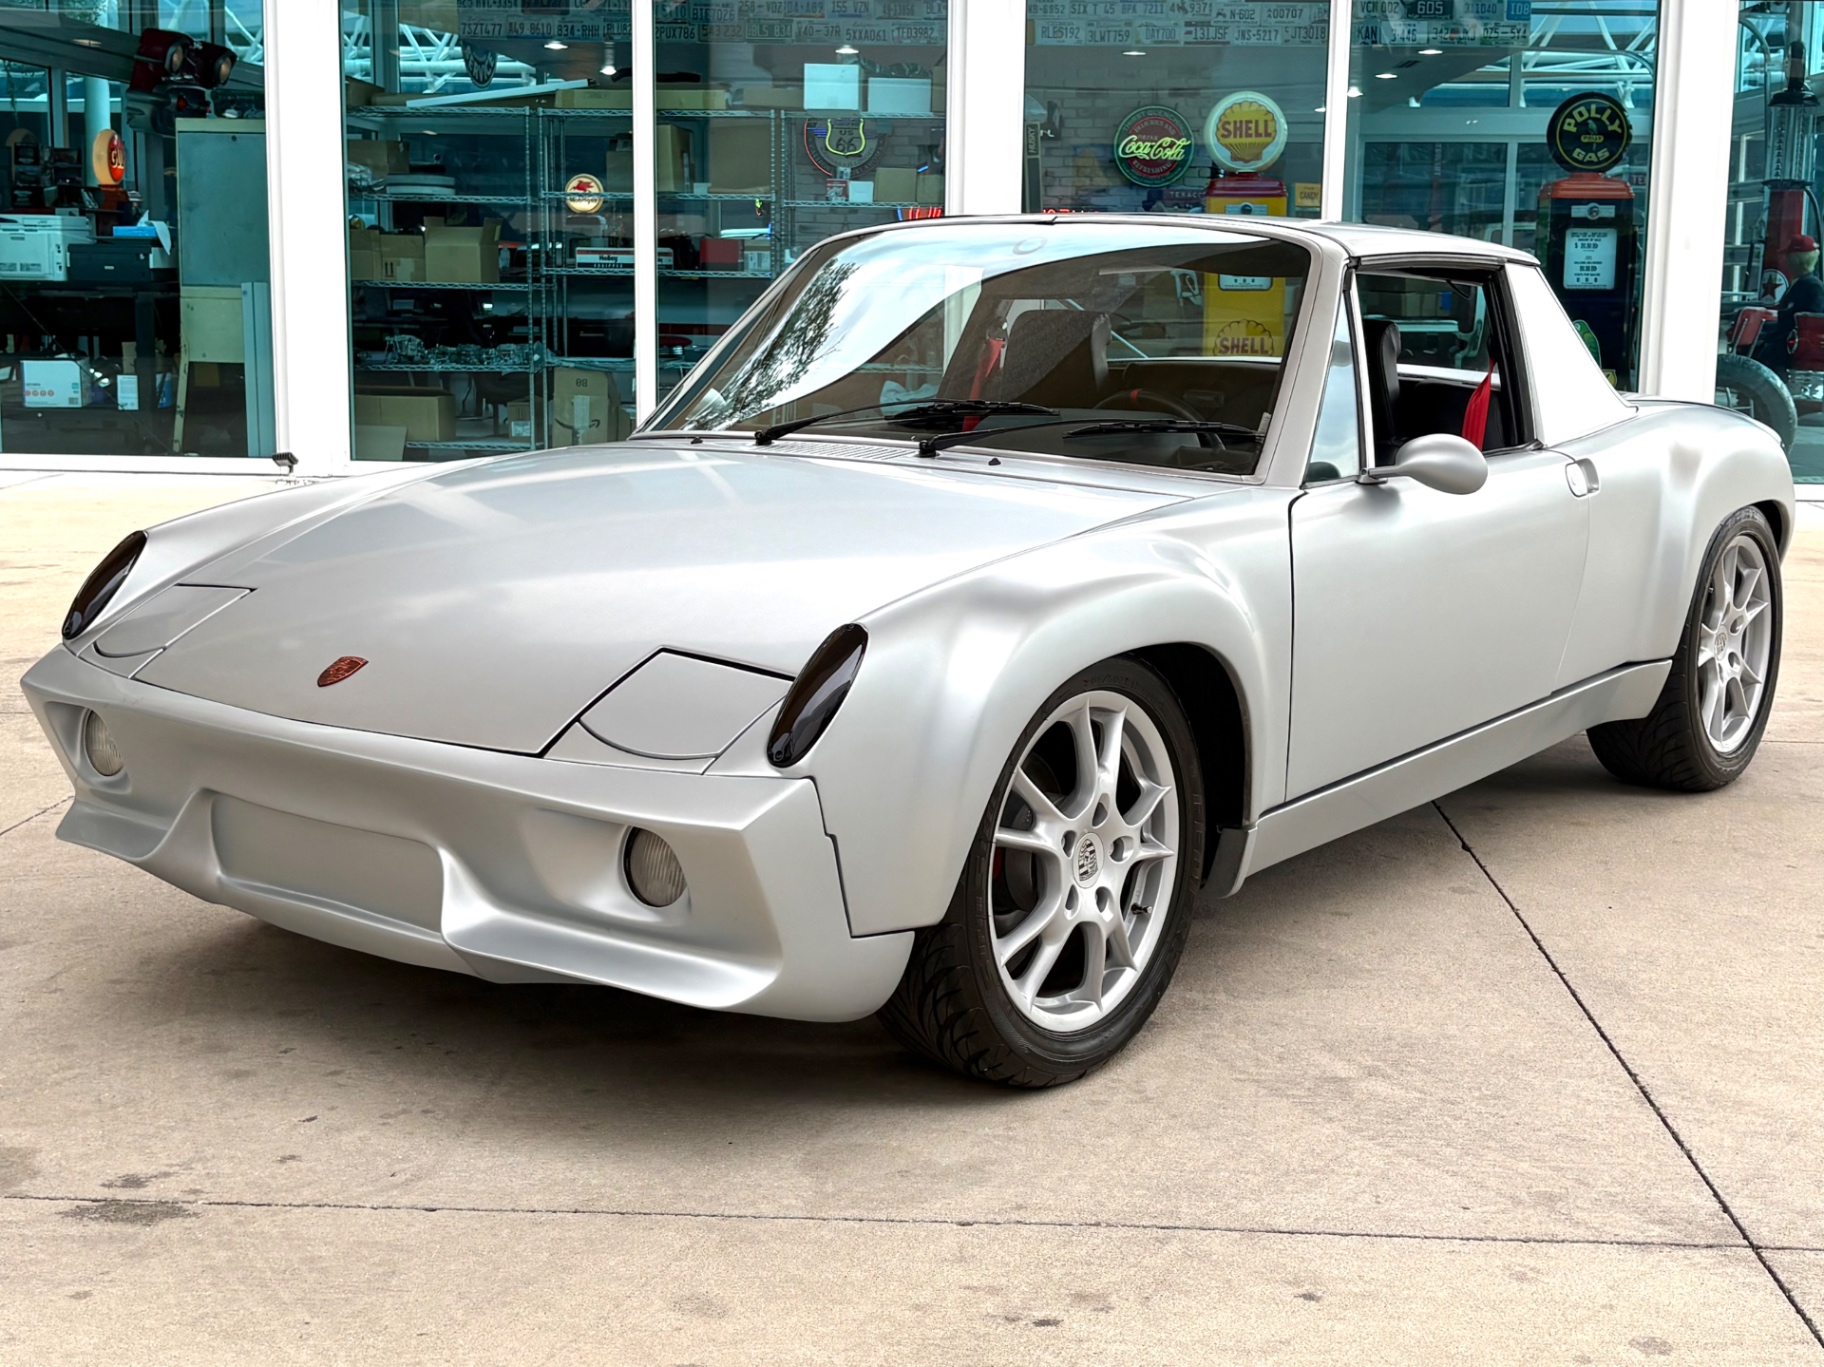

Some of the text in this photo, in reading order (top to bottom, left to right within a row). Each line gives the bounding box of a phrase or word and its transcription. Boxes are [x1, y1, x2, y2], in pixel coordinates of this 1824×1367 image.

[1563, 104, 1622, 133] POLLY
[1220, 119, 1273, 139] SHELL
[1118, 134, 1192, 161] Coca-Cola
[1572, 148, 1611, 162] GAS
[1219, 337, 1269, 355] SHELL
